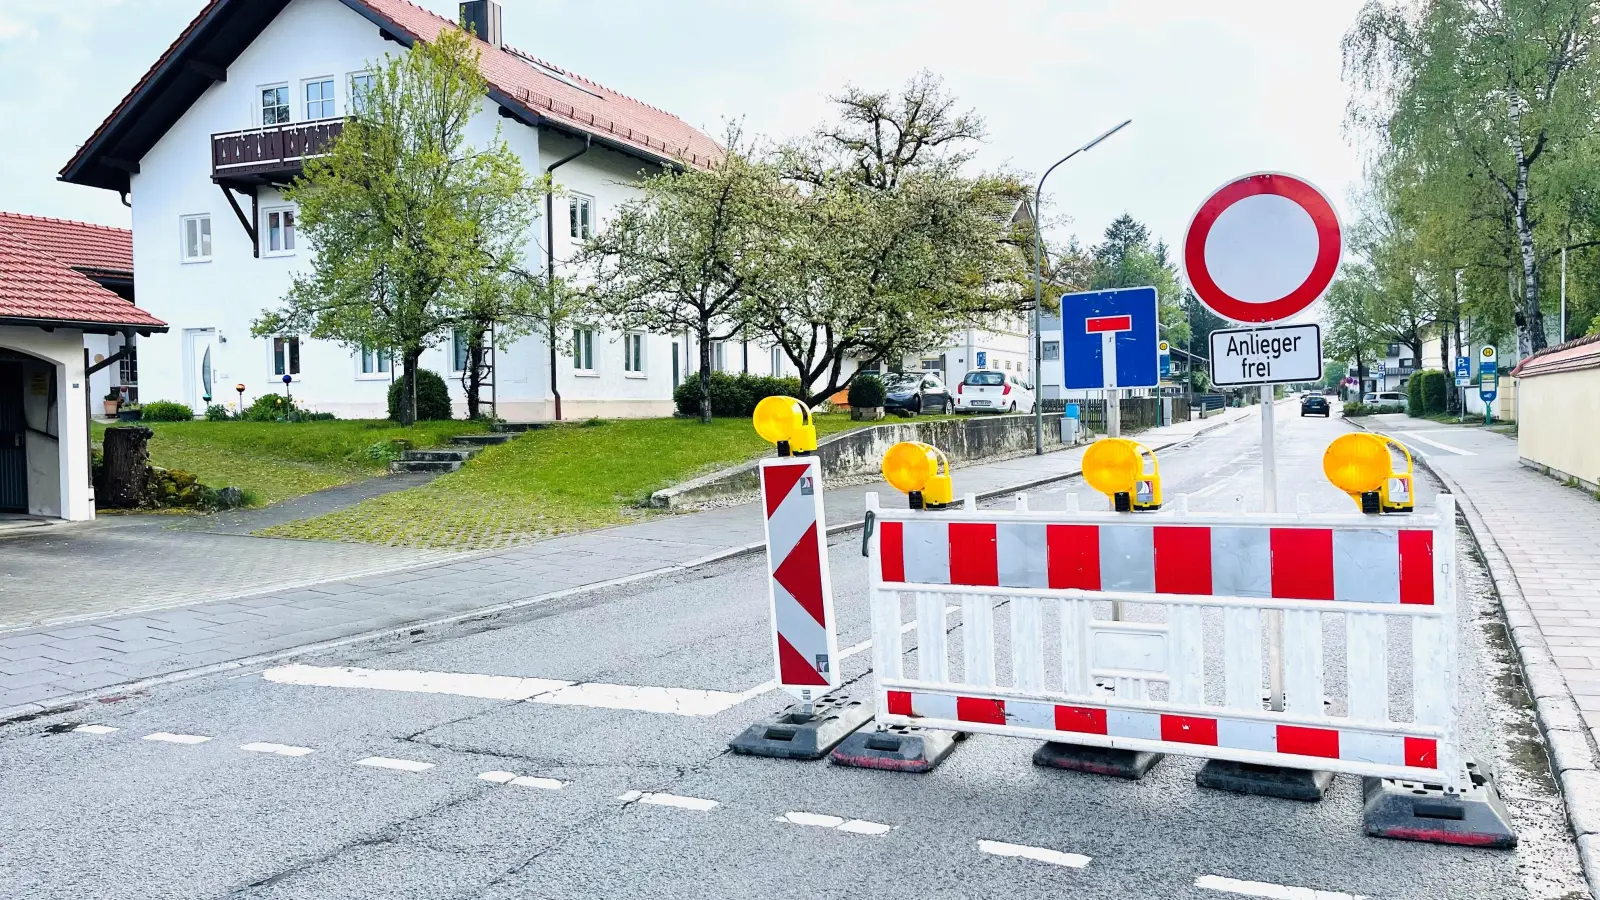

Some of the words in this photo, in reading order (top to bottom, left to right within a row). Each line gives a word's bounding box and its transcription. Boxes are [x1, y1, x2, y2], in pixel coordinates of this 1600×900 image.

[1226, 333, 1302, 359] Anlieger
[1242, 356, 1271, 378] frei
[1458, 358, 1465, 367] P
